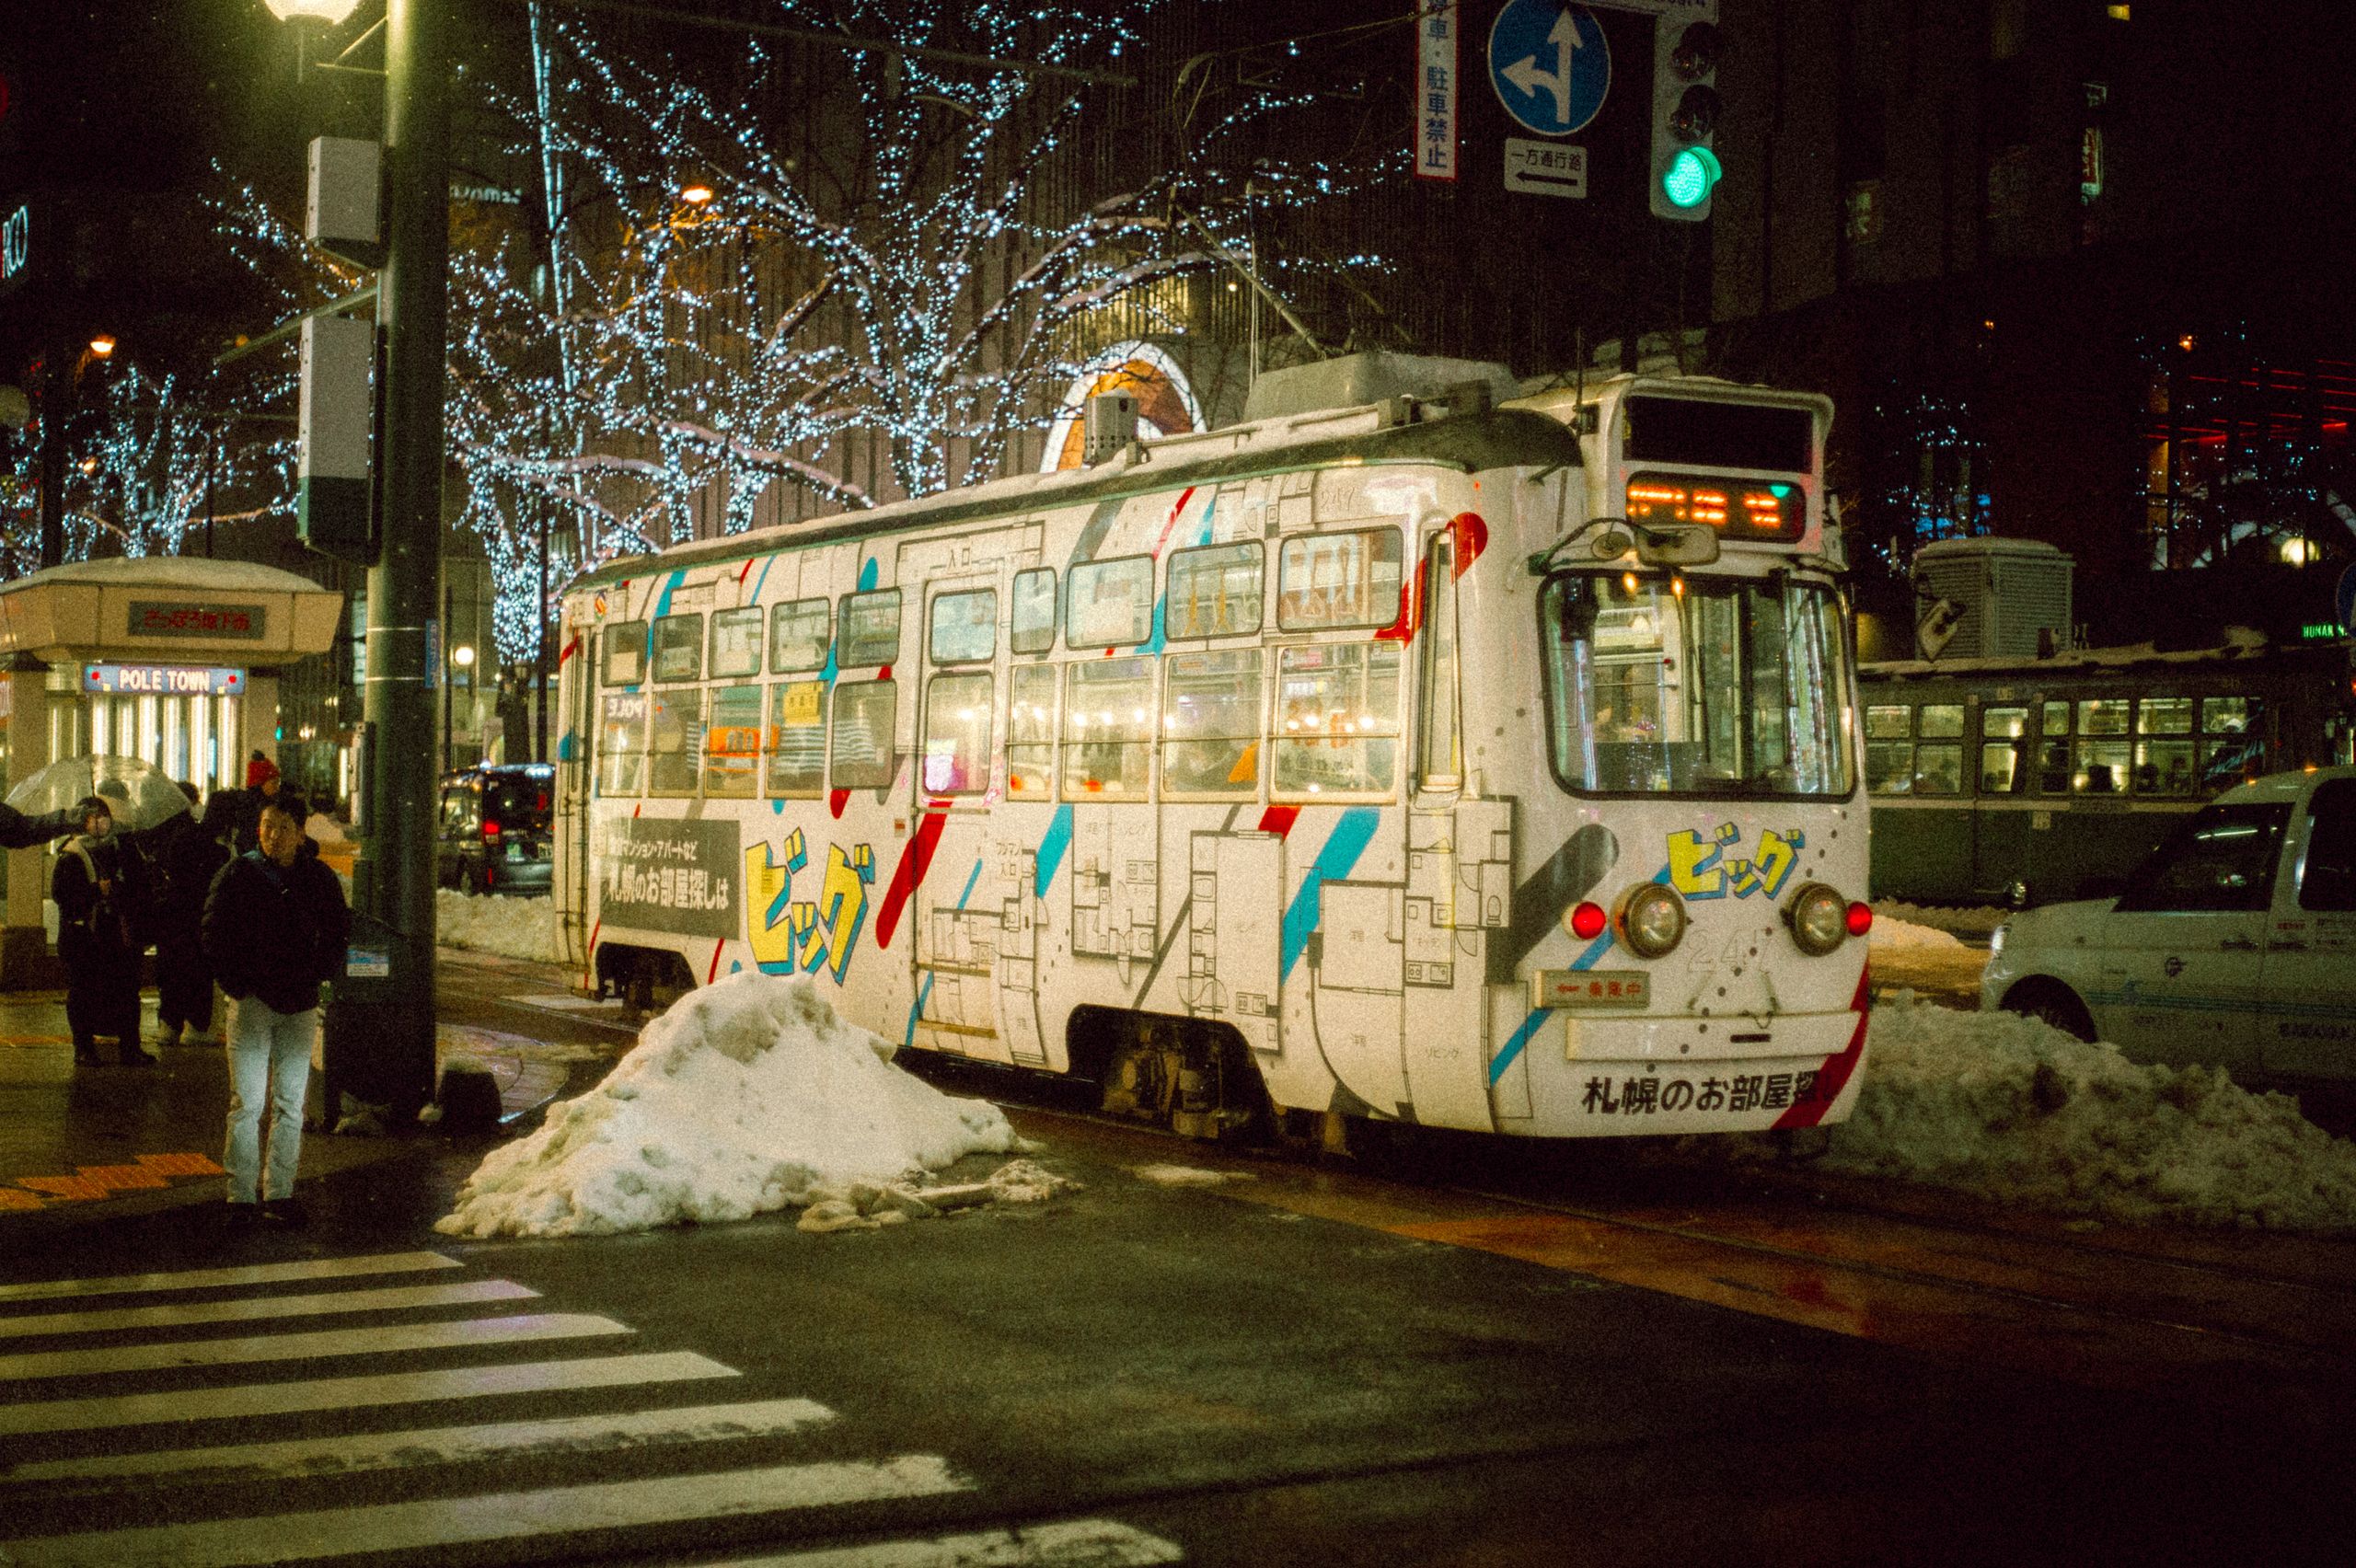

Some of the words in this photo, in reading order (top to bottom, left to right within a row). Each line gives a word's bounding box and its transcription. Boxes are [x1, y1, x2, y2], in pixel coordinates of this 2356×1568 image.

[1510, 148, 1582, 172] 一方通行路
[947, 548, 971, 571] 入口
[119, 669, 162, 691] POLE
[167, 670, 210, 692] TOWN
[1667, 821, 1804, 902] ビッグ
[745, 826, 875, 986] ビッグ
